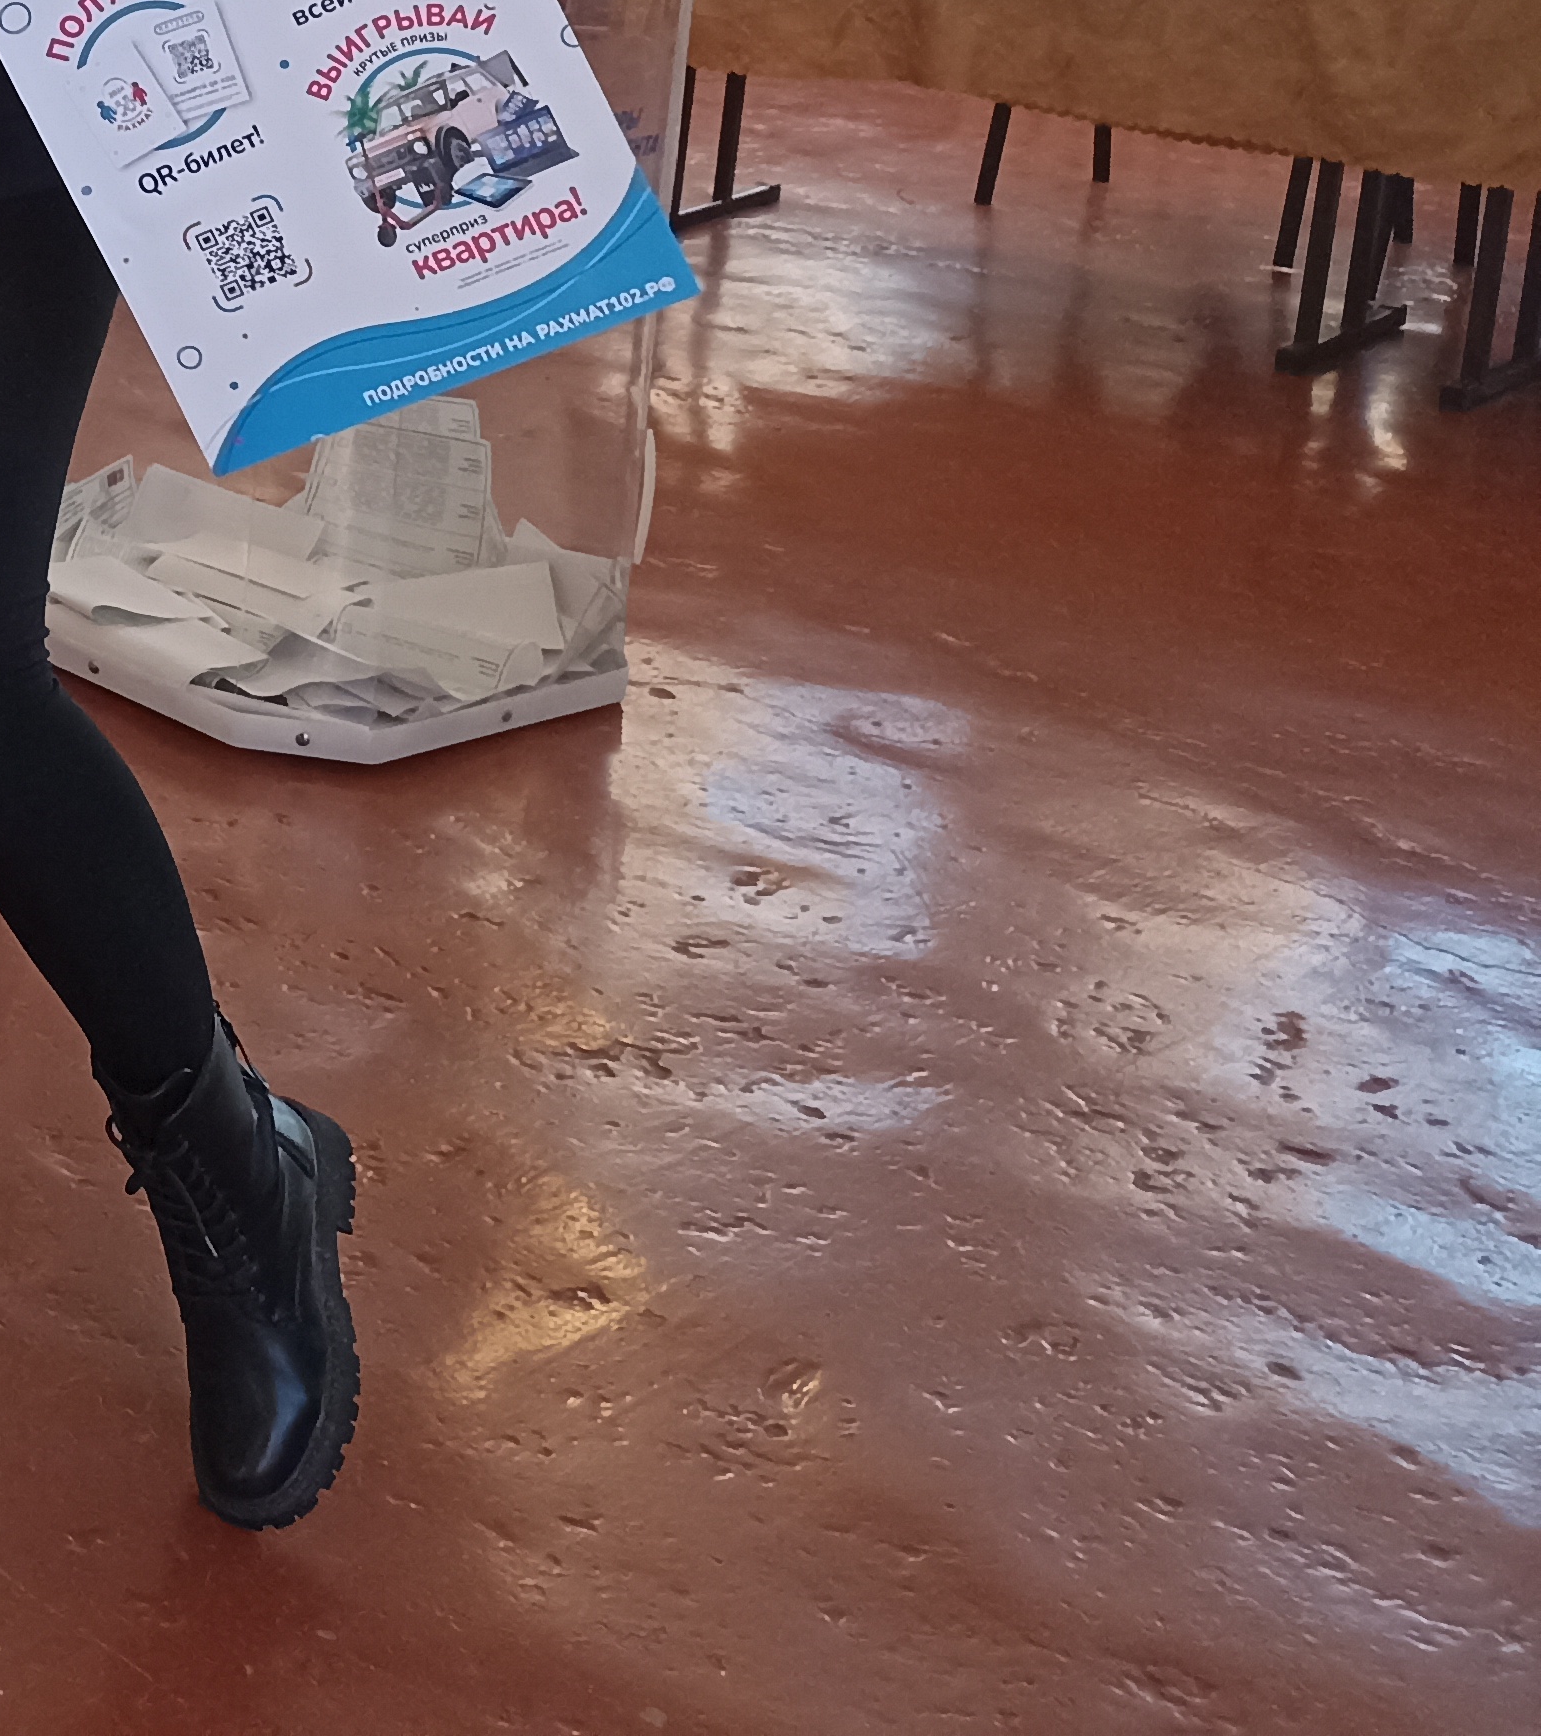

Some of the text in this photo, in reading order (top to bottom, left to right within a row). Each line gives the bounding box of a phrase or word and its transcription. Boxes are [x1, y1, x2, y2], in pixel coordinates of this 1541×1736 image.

[306, 3, 497, 102] ВЫИГРЫВАЙ
[353, 31, 448, 77] КРУТЫЕ ПРИЗЫ
[138, 124, 265, 196] QR-билет!
[405, 214, 488, 254] суперприз
[411, 186, 588, 280] квартира!
[362, 276, 677, 406] ПОДРОБНОСТИ НА РАХМАТ102.РФ
